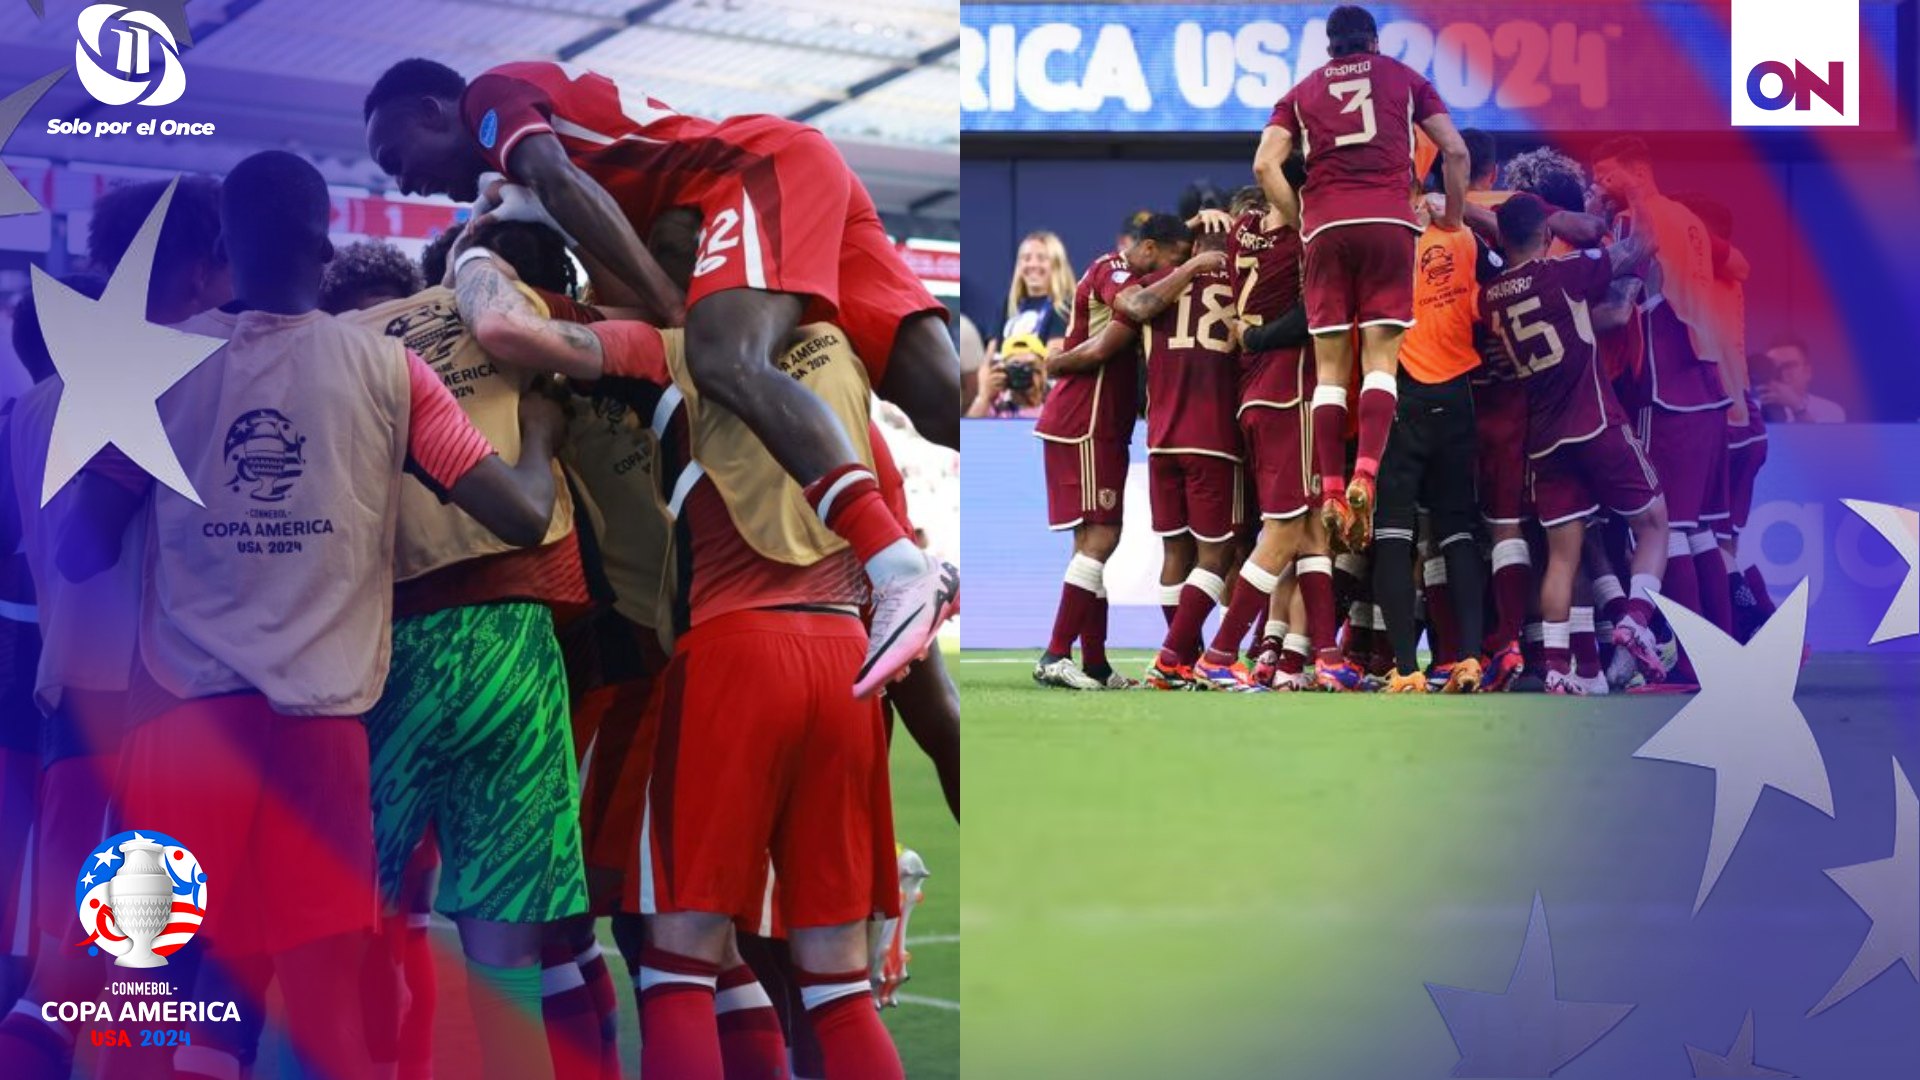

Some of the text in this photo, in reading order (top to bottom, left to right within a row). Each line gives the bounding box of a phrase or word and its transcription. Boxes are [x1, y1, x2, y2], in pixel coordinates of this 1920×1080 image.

[1328, 78, 1377, 146] 3
[1168, 283, 1236, 353] 18
[1491, 296, 1565, 379] 15
[791, 335, 839, 367] AMERICA
[202, 519, 334, 538] COPA AMERICA
[237, 541, 302, 554] USA 2024
